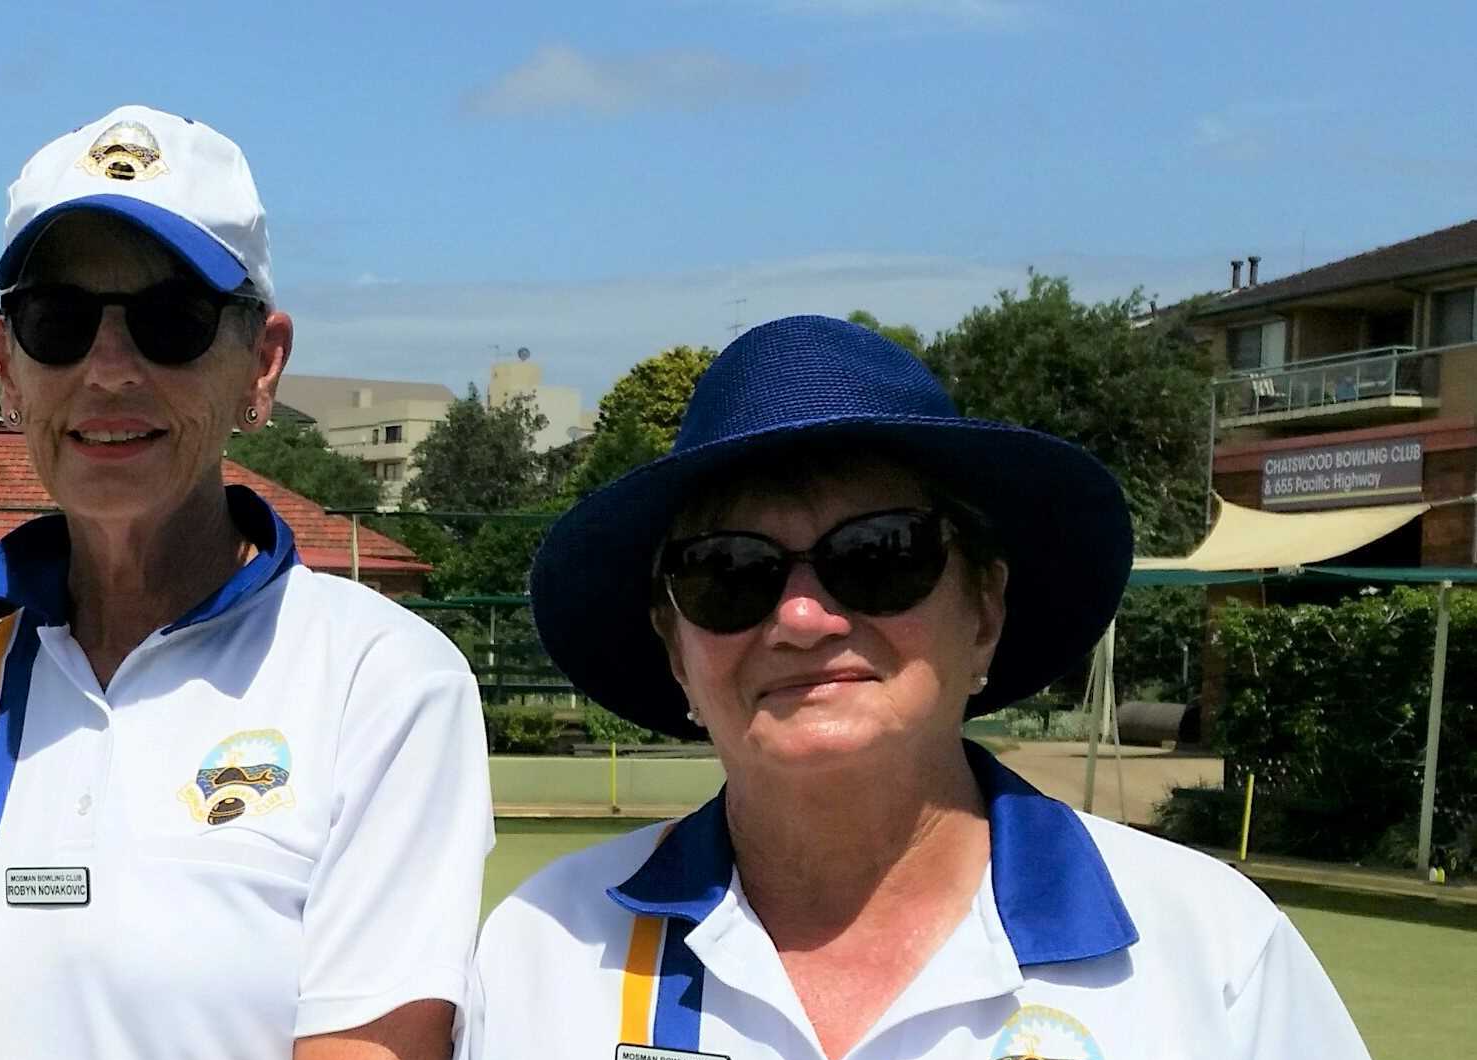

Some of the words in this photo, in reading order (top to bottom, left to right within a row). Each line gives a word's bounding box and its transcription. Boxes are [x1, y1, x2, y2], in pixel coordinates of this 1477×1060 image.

[1265, 453, 1333, 475] CHATSWOOD
[1336, 447, 1388, 468] BOWLING
[1390, 443, 1421, 463] CLUB
[1264, 479, 1271, 496] &
[1274, 477, 1293, 494] 655
[1295, 474, 1331, 493] Pacific
[1333, 472, 1382, 492] Highway
[10, 874, 36, 882] MOSMAN
[37, 874, 65, 882] BOWLING
[65, 874, 83, 882] CLUB
[8, 885, 37, 896] ROBYN
[38, 884, 86, 896] NOVAKOVIC
